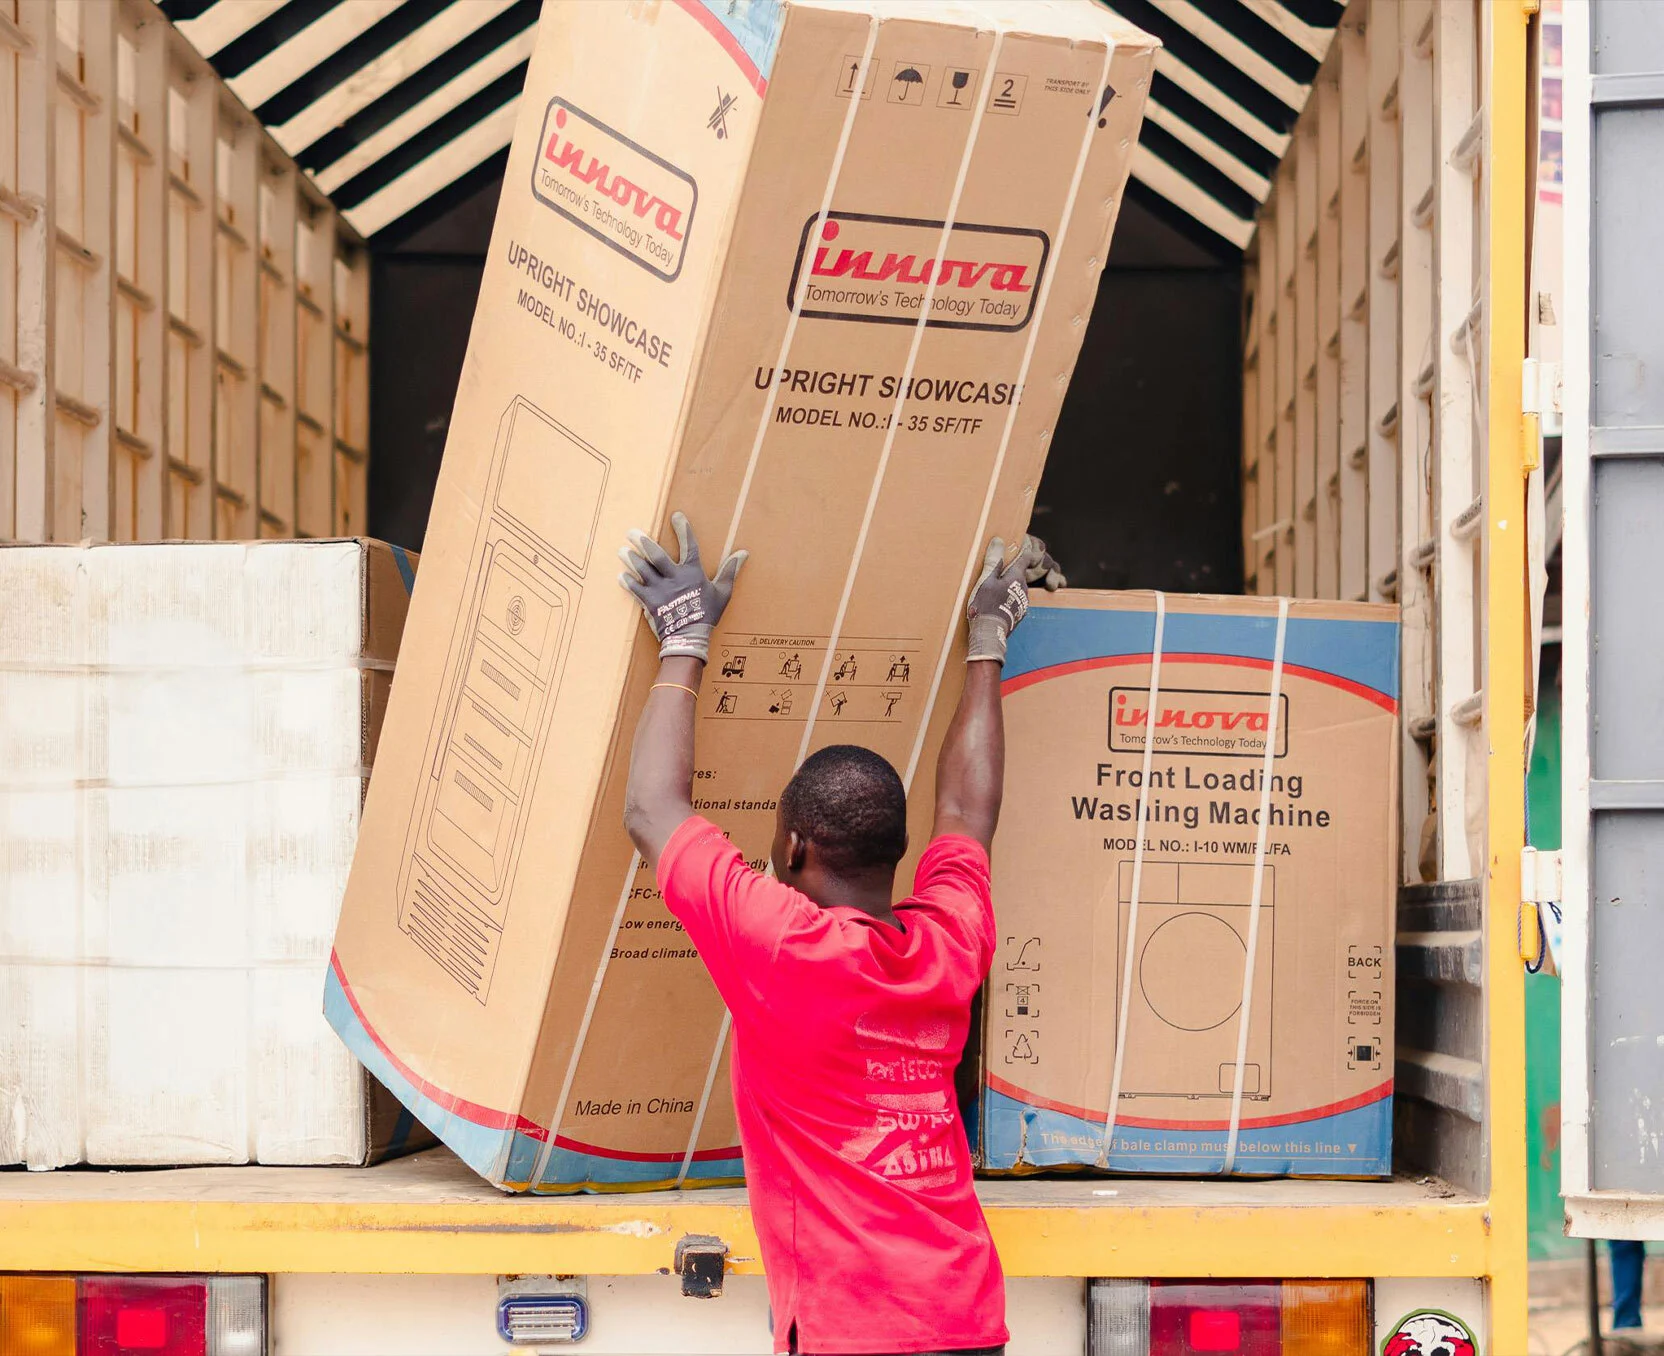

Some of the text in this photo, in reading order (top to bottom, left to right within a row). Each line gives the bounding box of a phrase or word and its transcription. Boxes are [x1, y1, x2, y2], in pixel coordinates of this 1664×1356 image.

[545, 108, 683, 241] innova
[542, 168, 674, 267] Tomorrow's Technology Today
[810, 220, 1032, 293] innova
[508, 240, 672, 368] UPRIGHT SHOWCASE
[806, 284, 889, 306] Tomorrow's
[980, 298, 1021, 319] Today
[517, 288, 556, 328] MODEL
[594, 341, 608, 362] 35
[609, 351, 643, 384] SF/TF
[755, 366, 874, 396] UPRIGHT
[776, 406, 842, 427] MODEL
[908, 415, 928, 432] 35
[933, 416, 983, 434] SF/TF
[1181, 736, 1236, 748] Technology
[1239, 738, 1267, 749] Today
[1097, 763, 1303, 798] Front Loading
[1209, 801, 1330, 828] Machine
[1104, 838, 1155, 851] MODL
[1194, 842, 1218, 854] I-10
[610, 948, 698, 958] Broad climate
[1348, 958, 1382, 967] BACK
[575, 1098, 694, 1116] Made in China
[1040, 1134, 1068, 1144] The
[1070, 1136, 1102, 1148] edge
[1121, 1138, 1150, 1150] bale
[1154, 1140, 1198, 1154] clamp
[1201, 1142, 1230, 1152] mus
[1240, 1140, 1280, 1153] below
[1285, 1142, 1311, 1153] this
[1315, 1142, 1340, 1153] line
